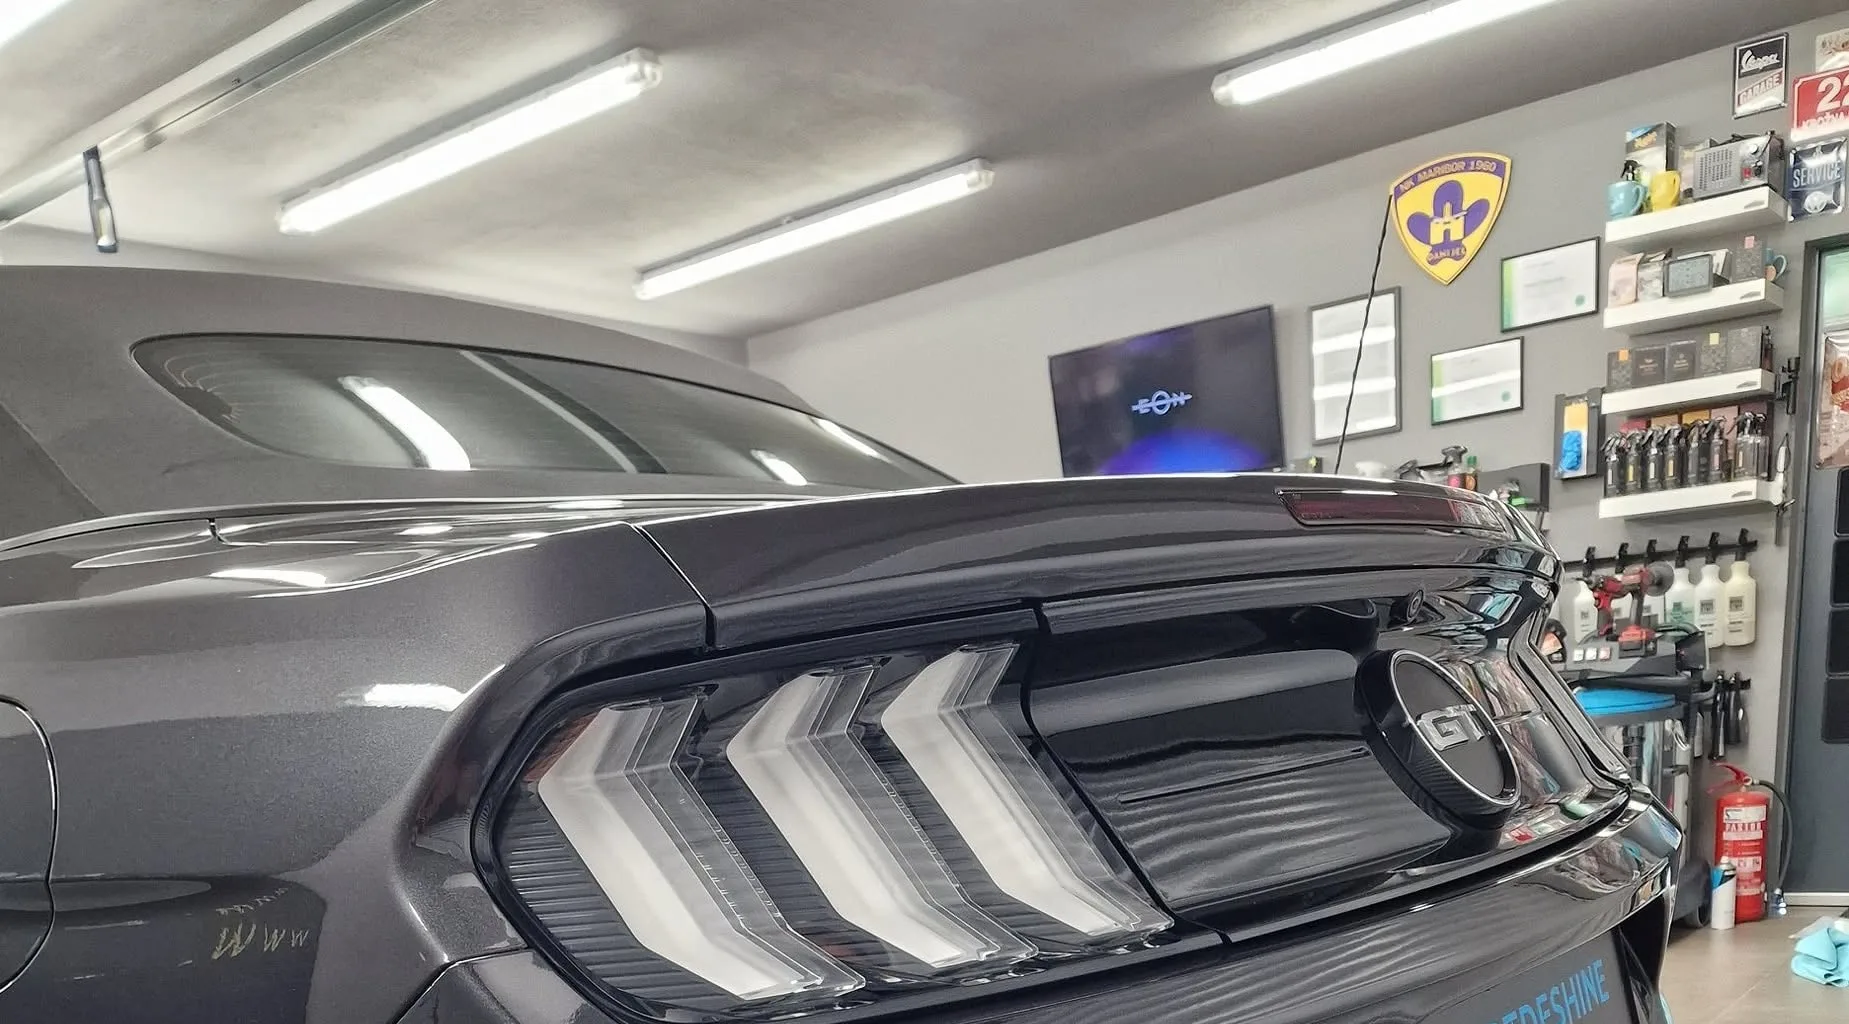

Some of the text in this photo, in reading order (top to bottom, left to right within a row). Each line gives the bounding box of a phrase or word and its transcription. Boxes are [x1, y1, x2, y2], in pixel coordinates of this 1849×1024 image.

[1739, 73, 1782, 106] GARAGE
[1792, 161, 1841, 188] SERVICE
[1416, 704, 1485, 751] GT
